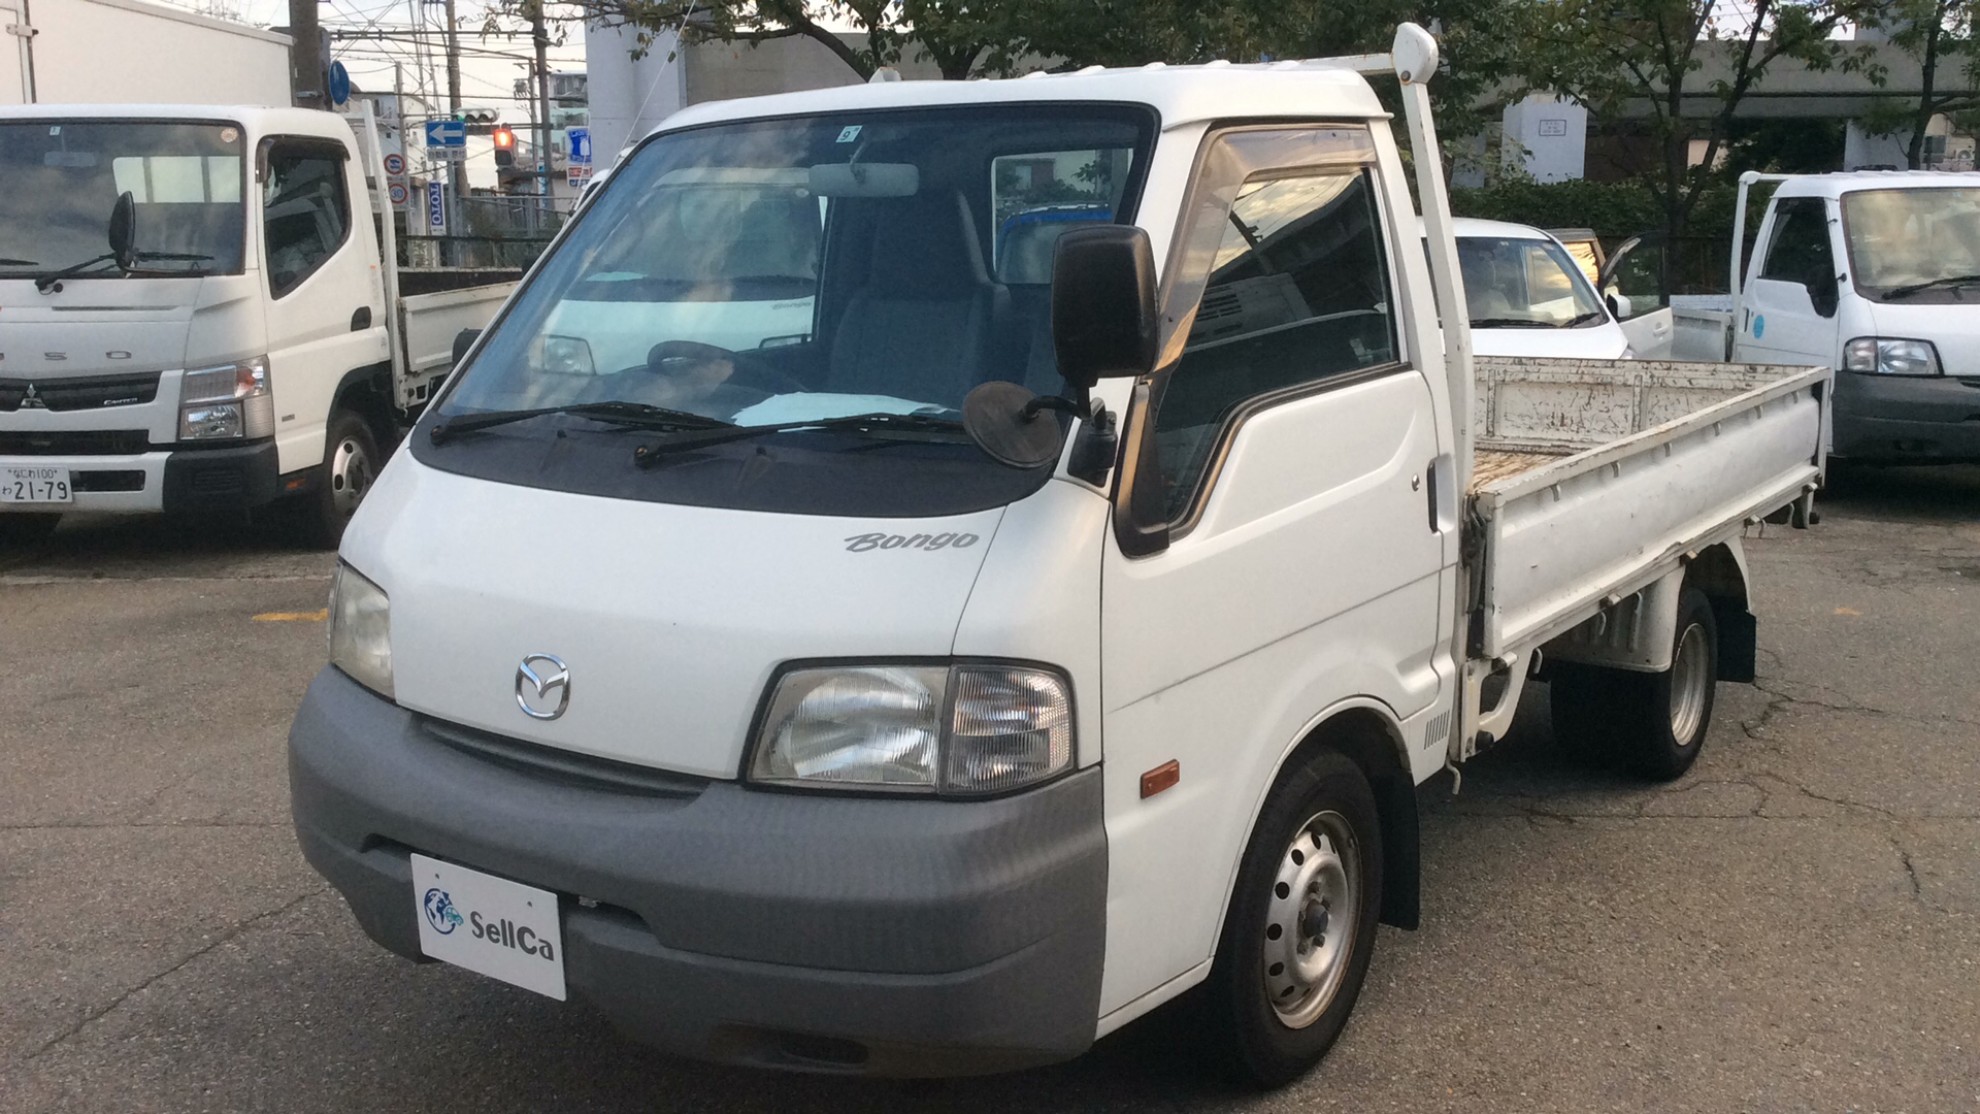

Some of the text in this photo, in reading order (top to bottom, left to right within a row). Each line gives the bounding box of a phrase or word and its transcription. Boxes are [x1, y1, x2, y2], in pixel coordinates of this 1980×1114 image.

[391, 188, 403, 198] 30
[430, 184, 442, 225] TOTO
[14, 481, 68, 500] 21-79
[844, 532, 980, 552] Bongo
[470, 911, 554, 961] SellCa
